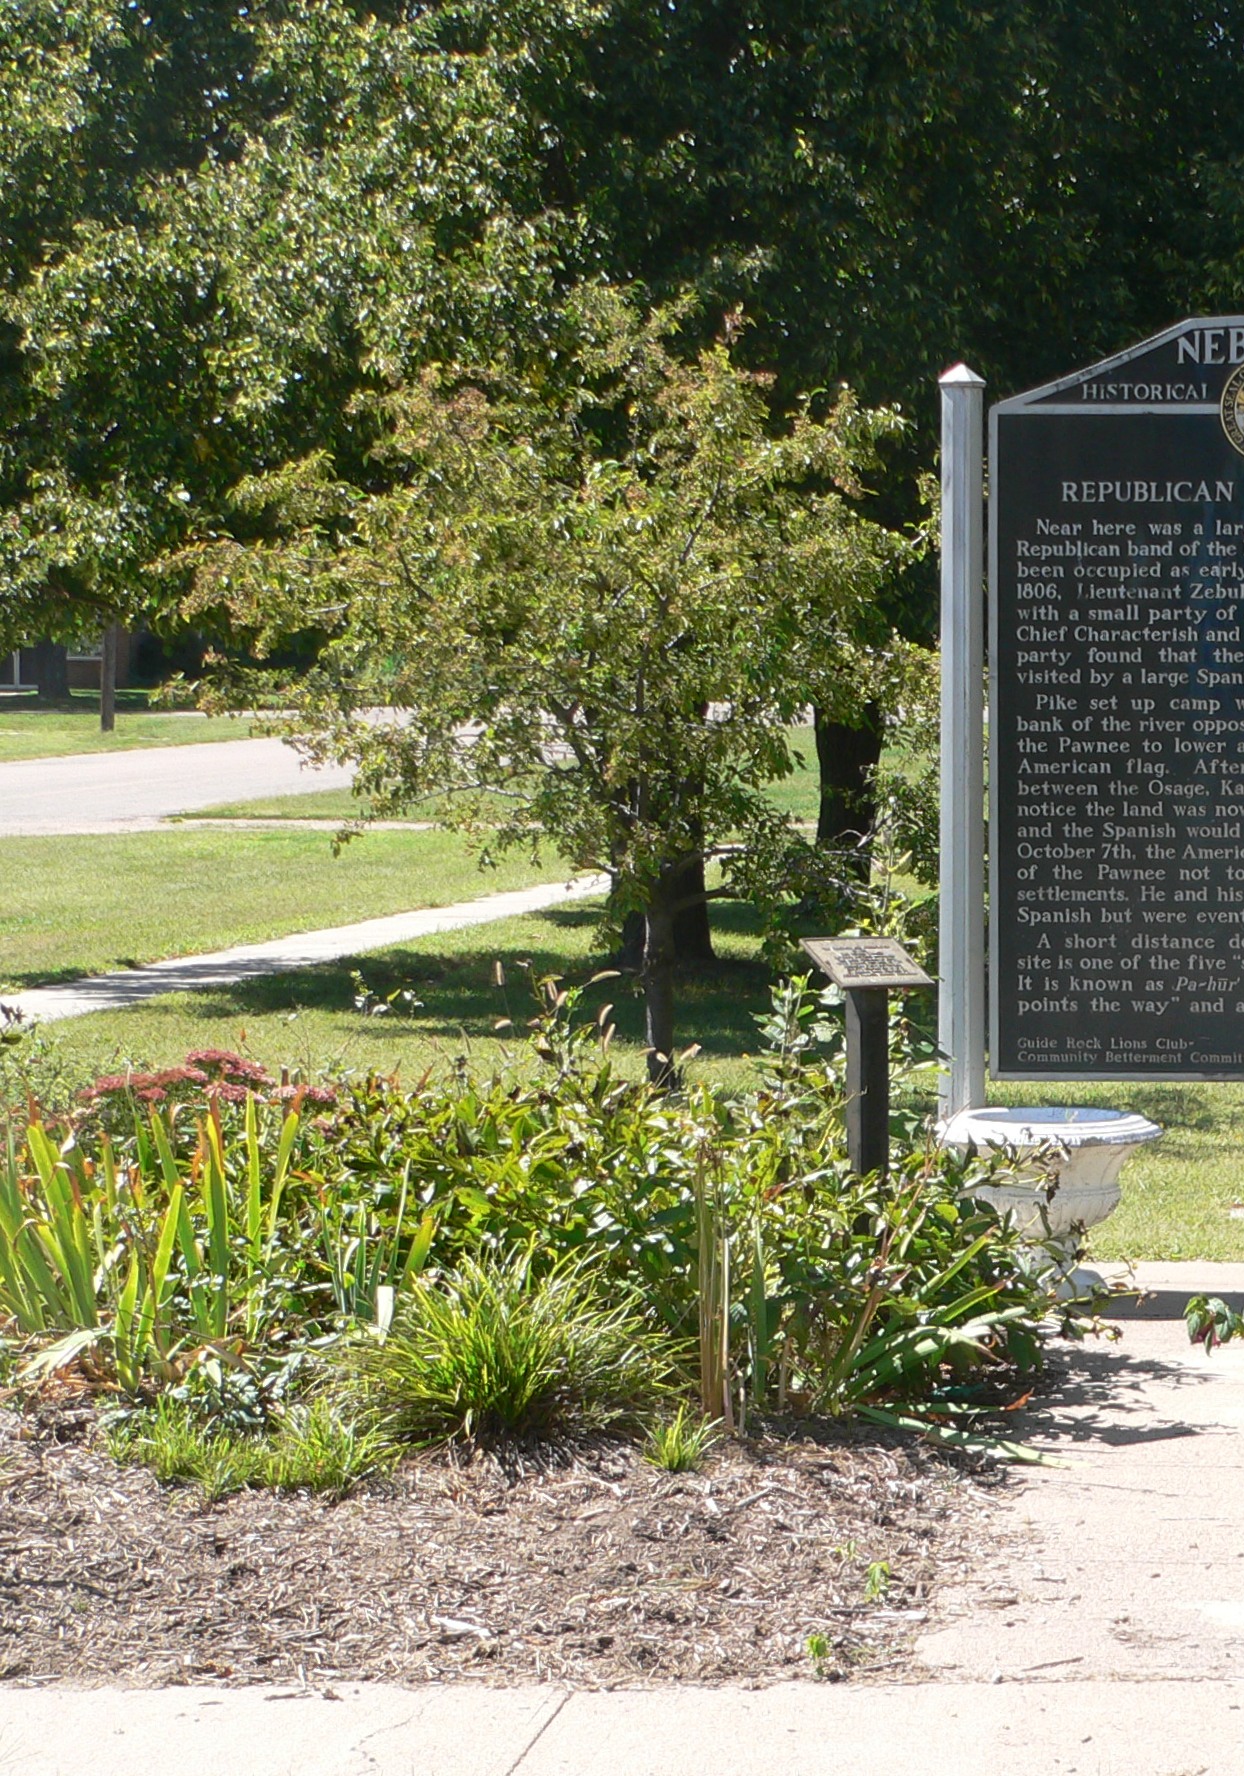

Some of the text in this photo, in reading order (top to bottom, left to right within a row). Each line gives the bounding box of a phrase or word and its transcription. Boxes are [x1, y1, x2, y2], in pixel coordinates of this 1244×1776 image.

[1082, 384, 1207, 400] HISTORICAL
[1225, 380, 1241, 407] SEAL
[1224, 409, 1242, 441] GREAT
[1062, 480, 1234, 502] REPUBLICAN
[1037, 519, 1082, 535] Near
[1092, 519, 1136, 535] here
[1148, 523, 1182, 535] was
[1193, 523, 1203, 535] a
[1017, 561, 1064, 577] been
[1074, 561, 1161, 580] occupied
[1170, 566, 1189, 577] as
[1016, 625, 1068, 641] Chief
[1074, 625, 1198, 642] Characterish
[1206, 626, 1240, 642] and
[1017, 648, 1071, 667] party
[1087, 647, 1142, 663] found
[1158, 647, 1197, 663] that
[1213, 648, 1244, 663] the
[1017, 668, 1081, 684] visited
[1090, 669, 1114, 687] by
[1122, 672, 1132, 684] a
[1141, 668, 1188, 687] large
[1017, 716, 1063, 732] bank
[1072, 716, 1093, 731] of
[1101, 716, 1131, 731] the
[1139, 717, 1185, 732] river
[1018, 758, 1111, 774] American
[1127, 758, 1169, 778] flag.
[1018, 780, 1098, 795] between
[1108, 780, 1138, 795] the
[1148, 780, 1209, 799] Osage,
[1017, 843, 1095, 859] October
[1102, 843, 1136, 860] 7th,
[1145, 844, 1175, 859] the
[1017, 865, 1038, 880] of
[1052, 865, 1082, 880] the
[1098, 864, 1165, 880] Pawnee
[1180, 866, 1210, 880] not
[1017, 886, 1128, 901] settlements.
[1141, 886, 1165, 901] He
[1174, 886, 1207, 901] and
[1217, 887, 1243, 901] his
[1017, 907, 1091, 926] Spanish
[1101, 908, 1132, 923] but
[1142, 912, 1186, 923] were
[1037, 933, 1051, 948] A
[1065, 934, 1116, 948] short
[1131, 933, 1214, 948] distance
[1017, 955, 1051, 969] site
[1058, 955, 1072, 969] is
[1080, 958, 1113, 969] one
[1120, 954, 1141, 969] of
[1149, 955, 1180, 970] the
[1188, 954, 1226, 970] five
[1018, 997, 1078, 1015] points
[1090, 997, 1120, 1012] the
[1190, 998, 1223, 1012] and
[1017, 1037, 1057, 1048] Guide
[1067, 1036, 1102, 1049] Rock
[1111, 1037, 1147, 1049] Lions
[1018, 1051, 1097, 1064] Community
[1106, 1051, 1181, 1063] Betterment
